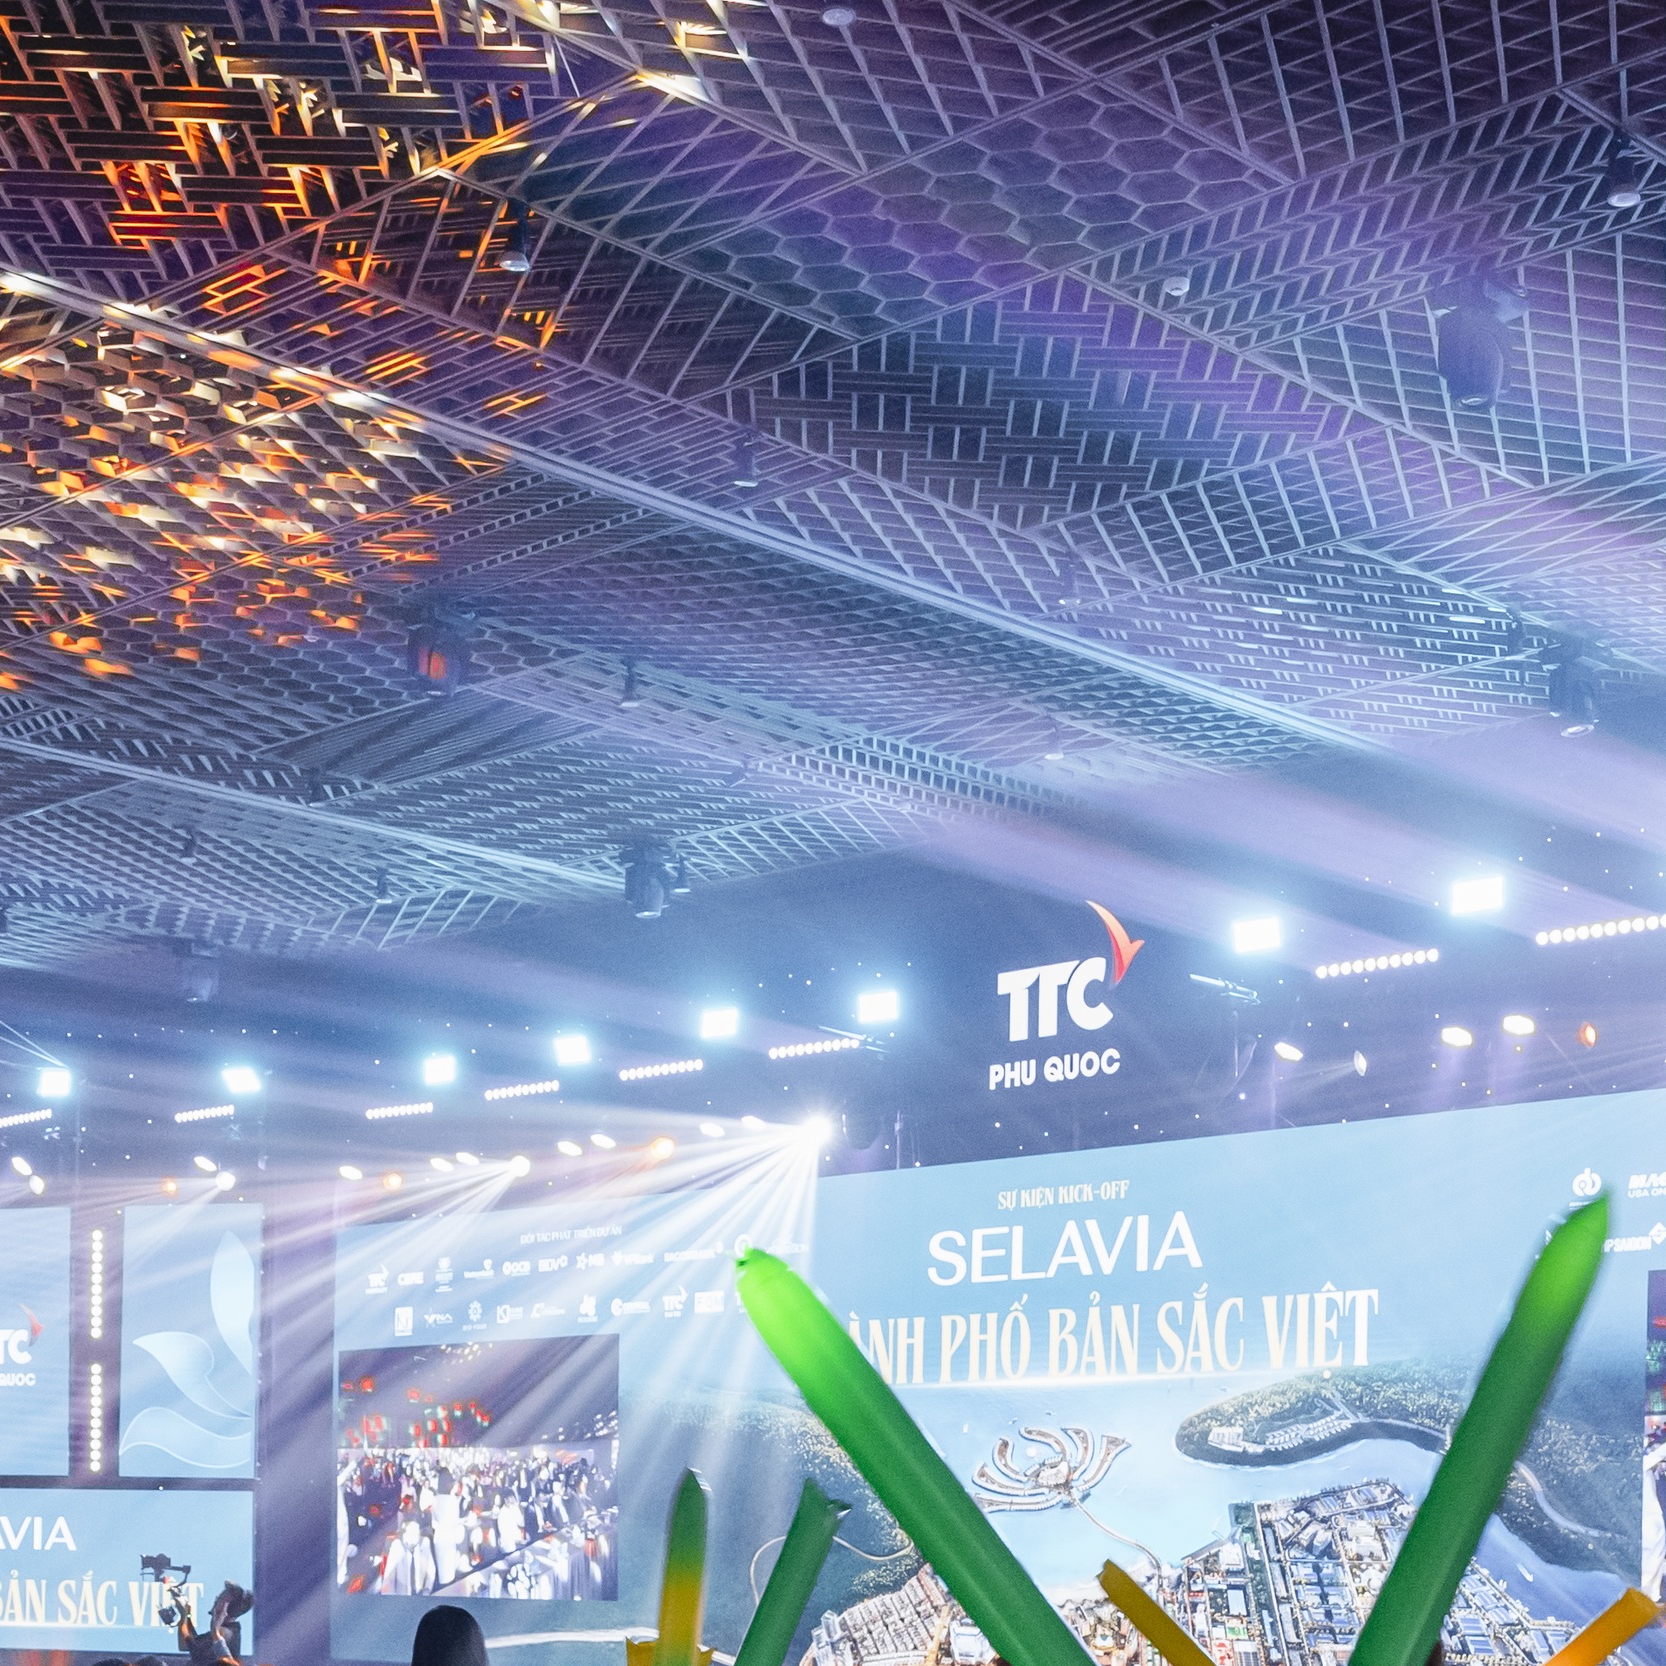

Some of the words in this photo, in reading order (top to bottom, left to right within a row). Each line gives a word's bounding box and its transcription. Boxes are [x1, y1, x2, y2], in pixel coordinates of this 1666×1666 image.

[997, 957, 1114, 1042] TTC
[989, 1059, 1036, 1091] PHU
[1043, 1048, 1121, 1083] QUOC
[997, 1188, 1018, 1212] SỰ
[1020, 1185, 1054, 1209] KIỆN
[1058, 1179, 1130, 1205] KICK-OFF
[927, 1210, 1203, 1287] SELAVIA
[939, 1294, 1031, 1383] PHỐ
[1048, 1290, 1142, 1379] BẢN
[1155, 1282, 1245, 1374] SẮC
[1262, 1281, 1379, 1380] VIỆT
[56, 1570, 118, 1626] SẮC
